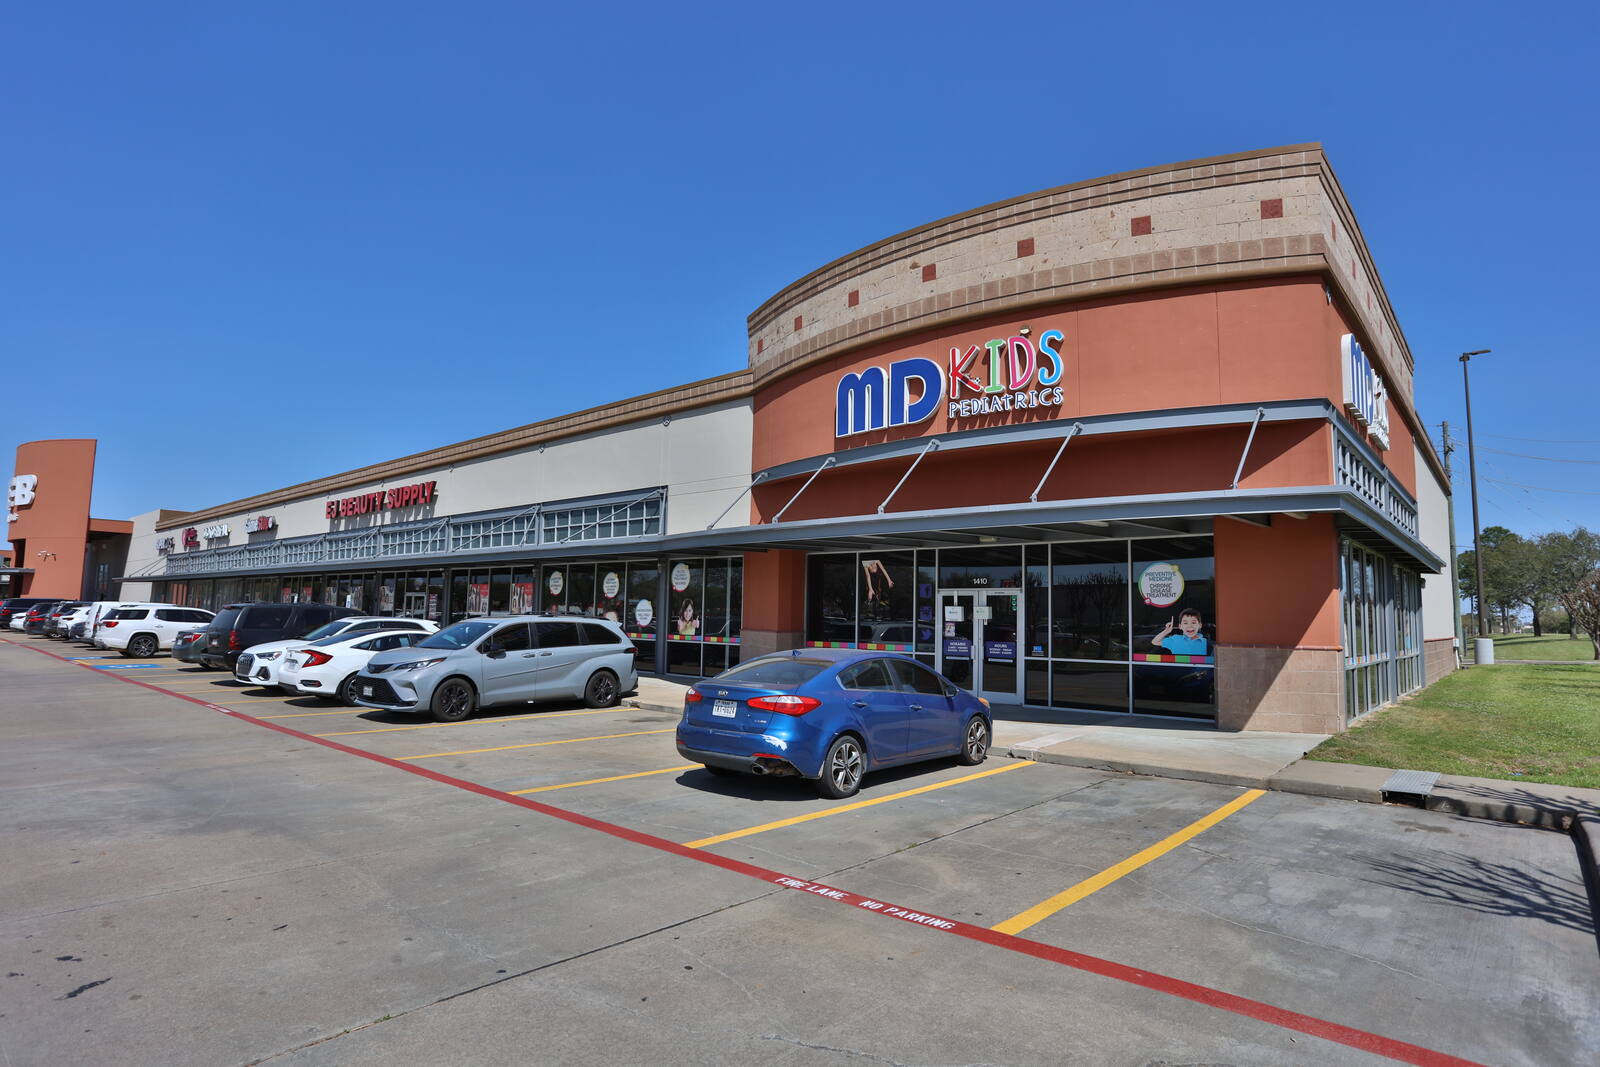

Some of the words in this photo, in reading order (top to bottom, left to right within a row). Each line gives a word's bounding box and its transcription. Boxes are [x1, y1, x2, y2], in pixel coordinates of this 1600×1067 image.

[836, 357, 945, 438] MD
[949, 329, 1064, 399] KIDS
[949, 387, 1064, 418] PEDIATRICS
[325, 500, 340, 519] EJ
[340, 491, 386, 517] BEAUTY
[386, 481, 437, 510] SUPPLY
[973, 577, 988, 585] 1410
[775, 876, 810, 890] FIRE
[806, 884, 849, 900] LANE
[858, 899, 883, 911] NO
[883, 906, 956, 931] PARKING
